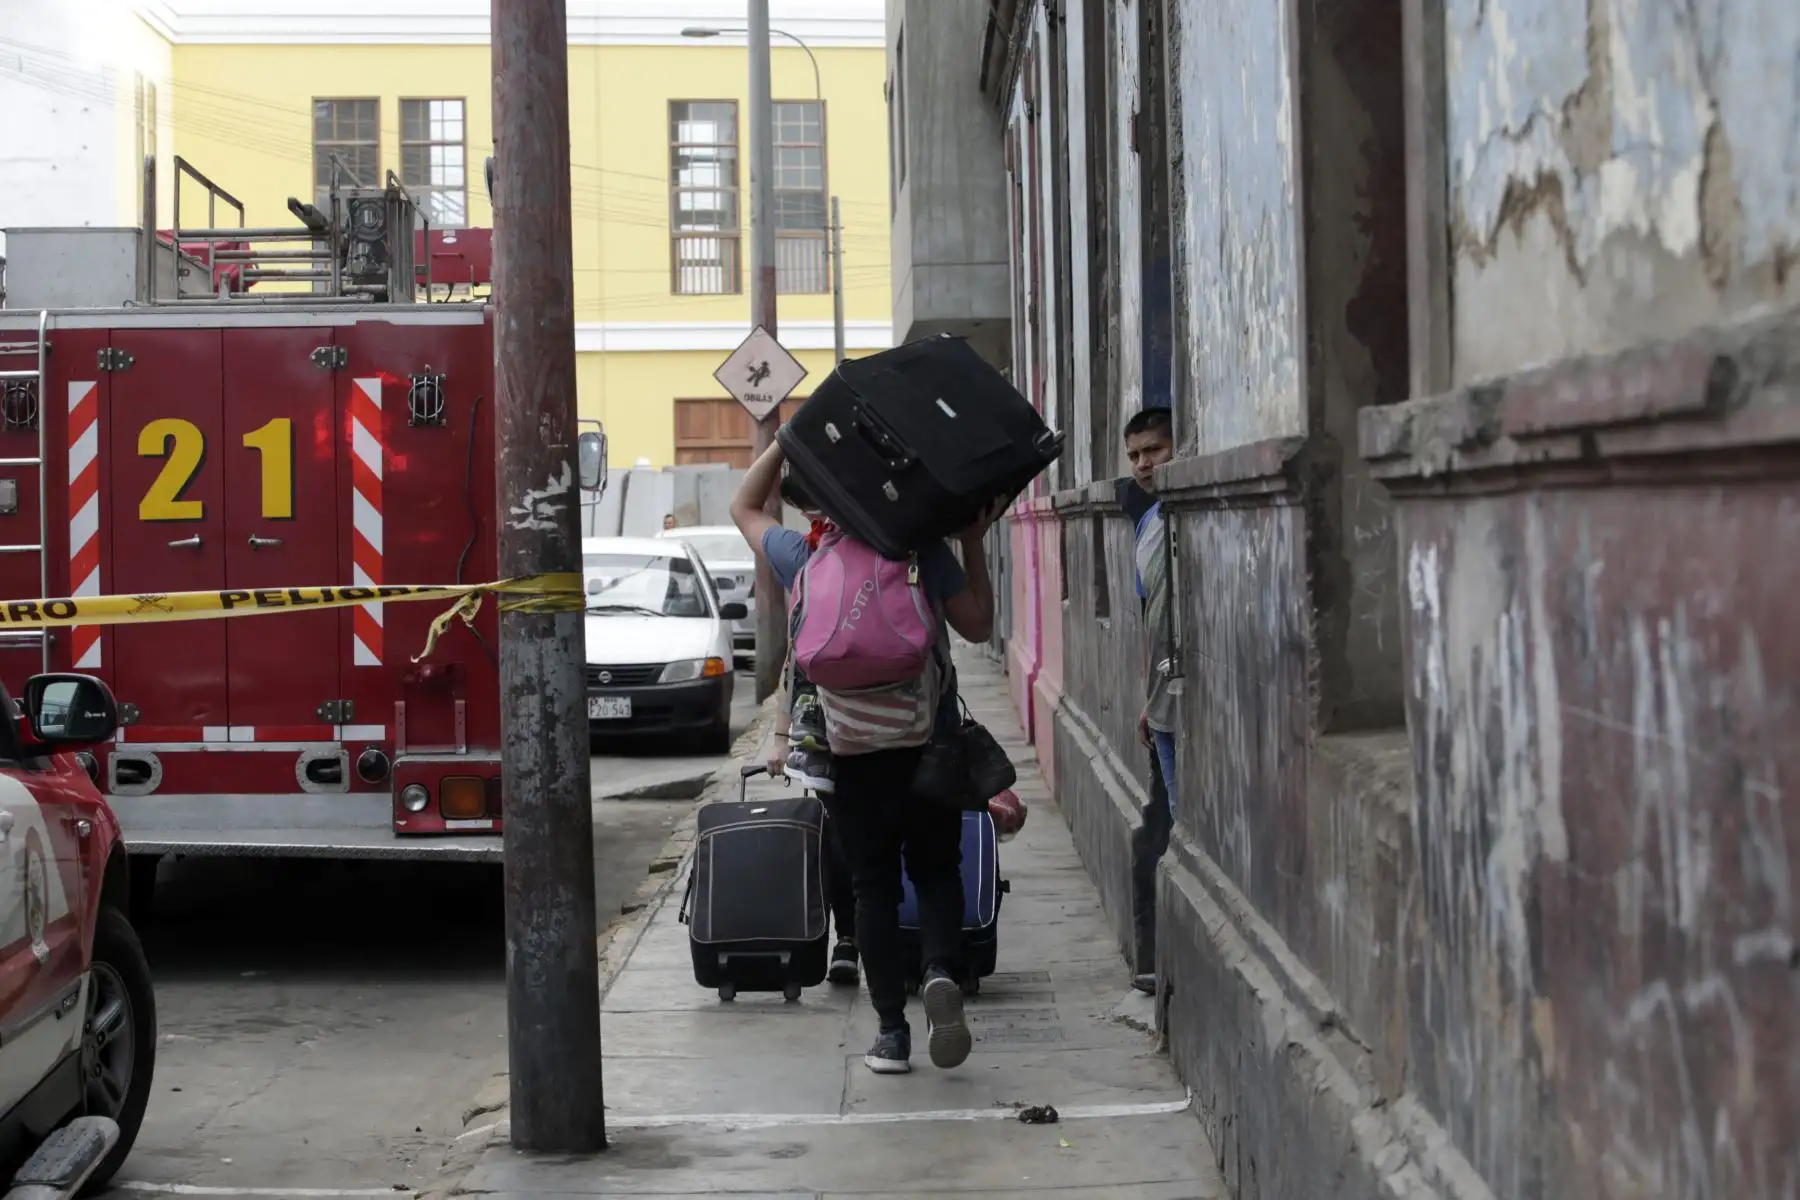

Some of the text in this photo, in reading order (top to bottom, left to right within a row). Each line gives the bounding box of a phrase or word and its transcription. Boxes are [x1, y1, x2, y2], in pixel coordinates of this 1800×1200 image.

[138, 418, 292, 520] 21
[0, 599, 77, 622] RO
[840, 579, 875, 631] TOTTO
